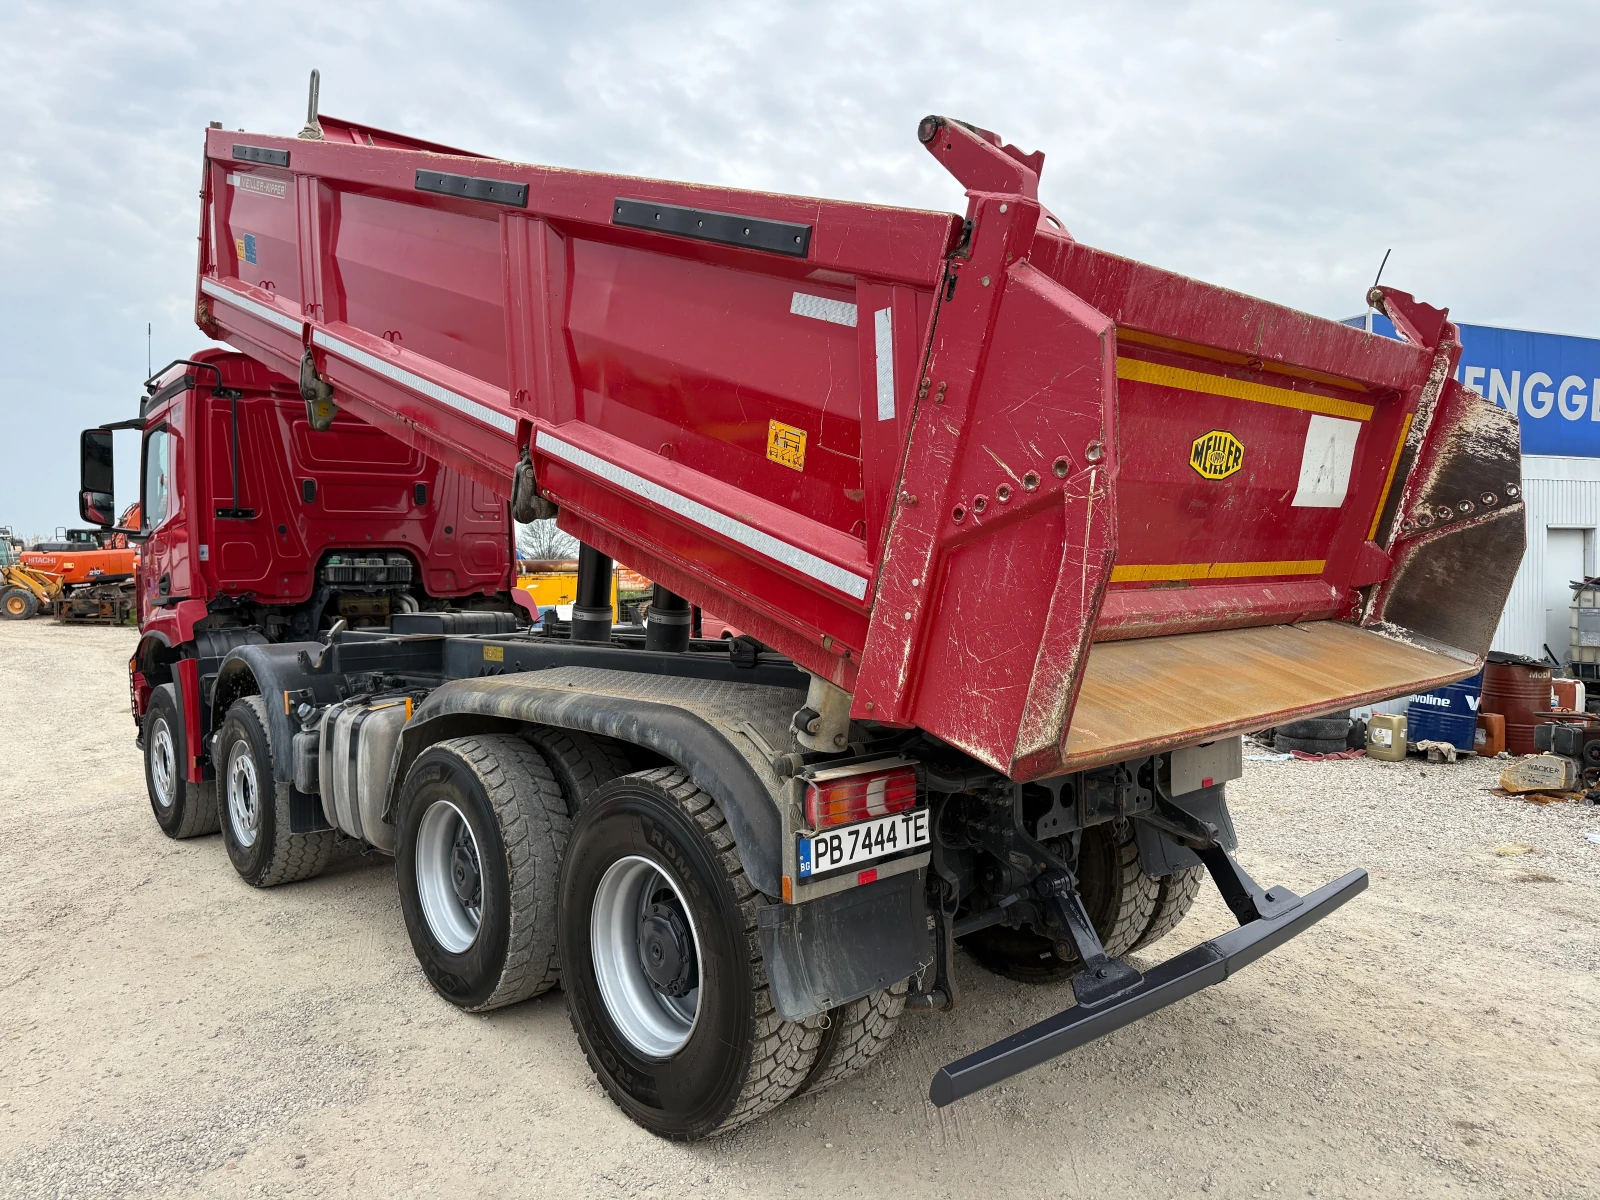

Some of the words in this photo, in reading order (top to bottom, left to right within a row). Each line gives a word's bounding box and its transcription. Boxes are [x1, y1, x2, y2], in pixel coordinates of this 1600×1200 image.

[1453, 365, 1600, 421] ENGGE
[1192, 435, 1242, 475] MEILLER
[1527, 764, 1560, 774] WACKER
[651, 827, 702, 899] RDM2
[814, 834, 844, 869] PB
[847, 820, 898, 861] 7444
[901, 813, 926, 845] TE
[800, 861, 811, 873] BG
